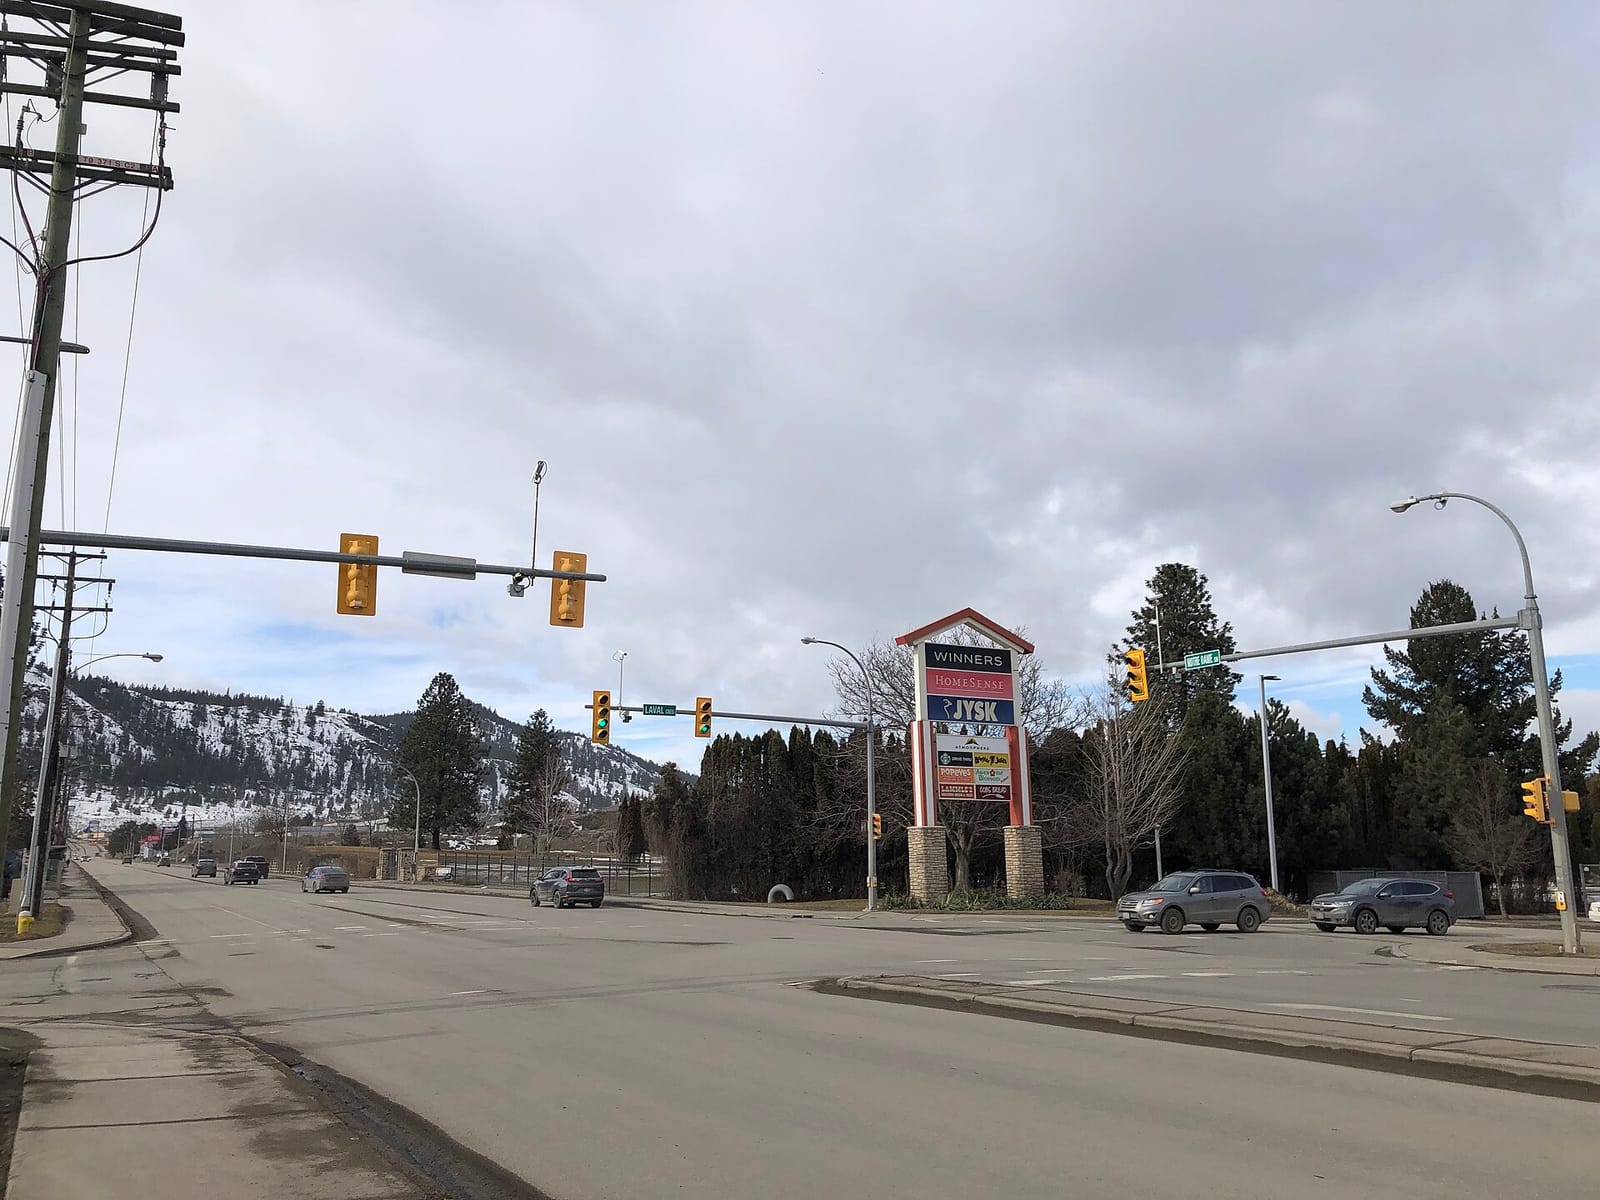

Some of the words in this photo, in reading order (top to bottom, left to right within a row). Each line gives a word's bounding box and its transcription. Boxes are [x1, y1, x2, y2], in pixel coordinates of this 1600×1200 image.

[934, 651, 1003, 667] WINNERS
[645, 705, 664, 714] LAVAL
[953, 699, 999, 722] JYSK
[940, 768, 971, 777] POPEYES
